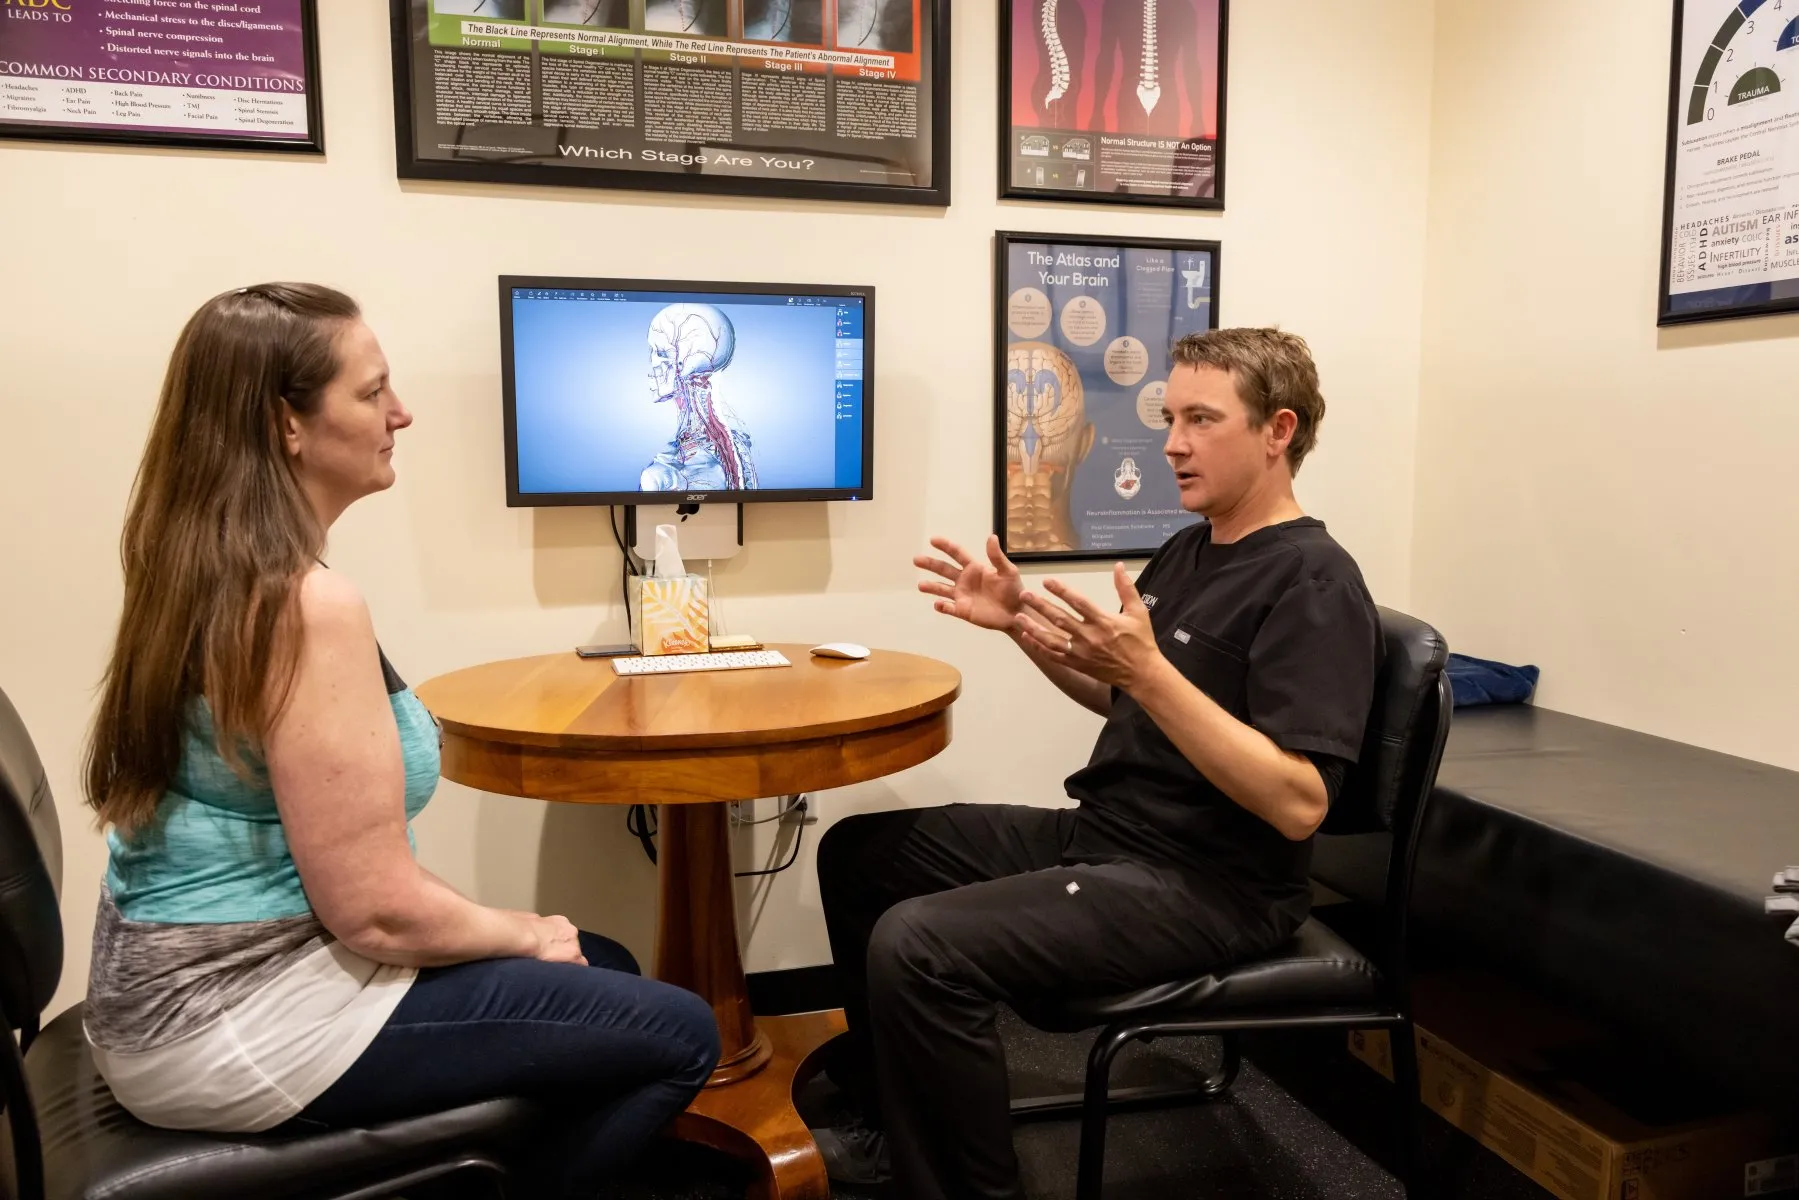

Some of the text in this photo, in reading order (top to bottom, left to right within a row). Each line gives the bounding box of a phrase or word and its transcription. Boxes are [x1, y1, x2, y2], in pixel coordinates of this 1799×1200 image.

[194, 1, 208, 10] the
[212, 3, 238, 12] spinal
[1774, 0, 1782, 11] 4
[8, 9, 72, 23] LEADS TO
[105, 10, 158, 22] Mechanical
[160, 16, 185, 24] stress
[201, 18, 215, 26] the
[218, 20, 283, 31] discs/ligaments
[106, 26, 135, 37] Spinal
[166, 33, 224, 43] compression
[1747, 21, 1754, 34] 3
[462, 37, 501, 48] Normal
[468, 24, 890, 66] The Black Line Represents Normal Alignment, While The Red Line Represents The Patient's Abnormal Alignment
[107, 43, 152, 54] Distorted
[182, 50, 213, 59] signals
[235, 53, 250, 61] the
[252, 54, 274, 62] brain
[569, 45, 598, 56] Stage
[1726, 49, 1733, 62] 2
[670, 53, 698, 64] Stage
[765, 61, 791, 71] Stage
[0, 61, 304, 92] COMMON SECONDARY CONDITIONS
[859, 68, 884, 79] Stage
[1714, 81, 1718, 93] 1
[1738, 85, 1769, 100] TRAUMA
[1707, 108, 1714, 120] 0
[1101, 137, 1126, 146] Normal
[1127, 138, 1156, 148] Structure
[1166, 141, 1180, 149] NOT
[1191, 143, 1212, 152] Option
[559, 145, 815, 170] Which Stage Are You?
[1717, 156, 1738, 166] BRAKE
[1740, 150, 1760, 160] PEDAL
[1681, 216, 1729, 230] HEADACHES
[1762, 213, 1780, 224] EAR
[1712, 220, 1758, 237] AUTISM
[1711, 236, 1739, 247] anxiety
[1785, 234, 1799, 244] as
[1698, 228, 1708, 271] ADHD
[1710, 247, 1761, 262] INFERTILITY
[1027, 251, 1119, 268] The Atlas and
[1677, 242, 1686, 283] BEHAVIOR
[1038, 272, 1108, 287] Your Brain
